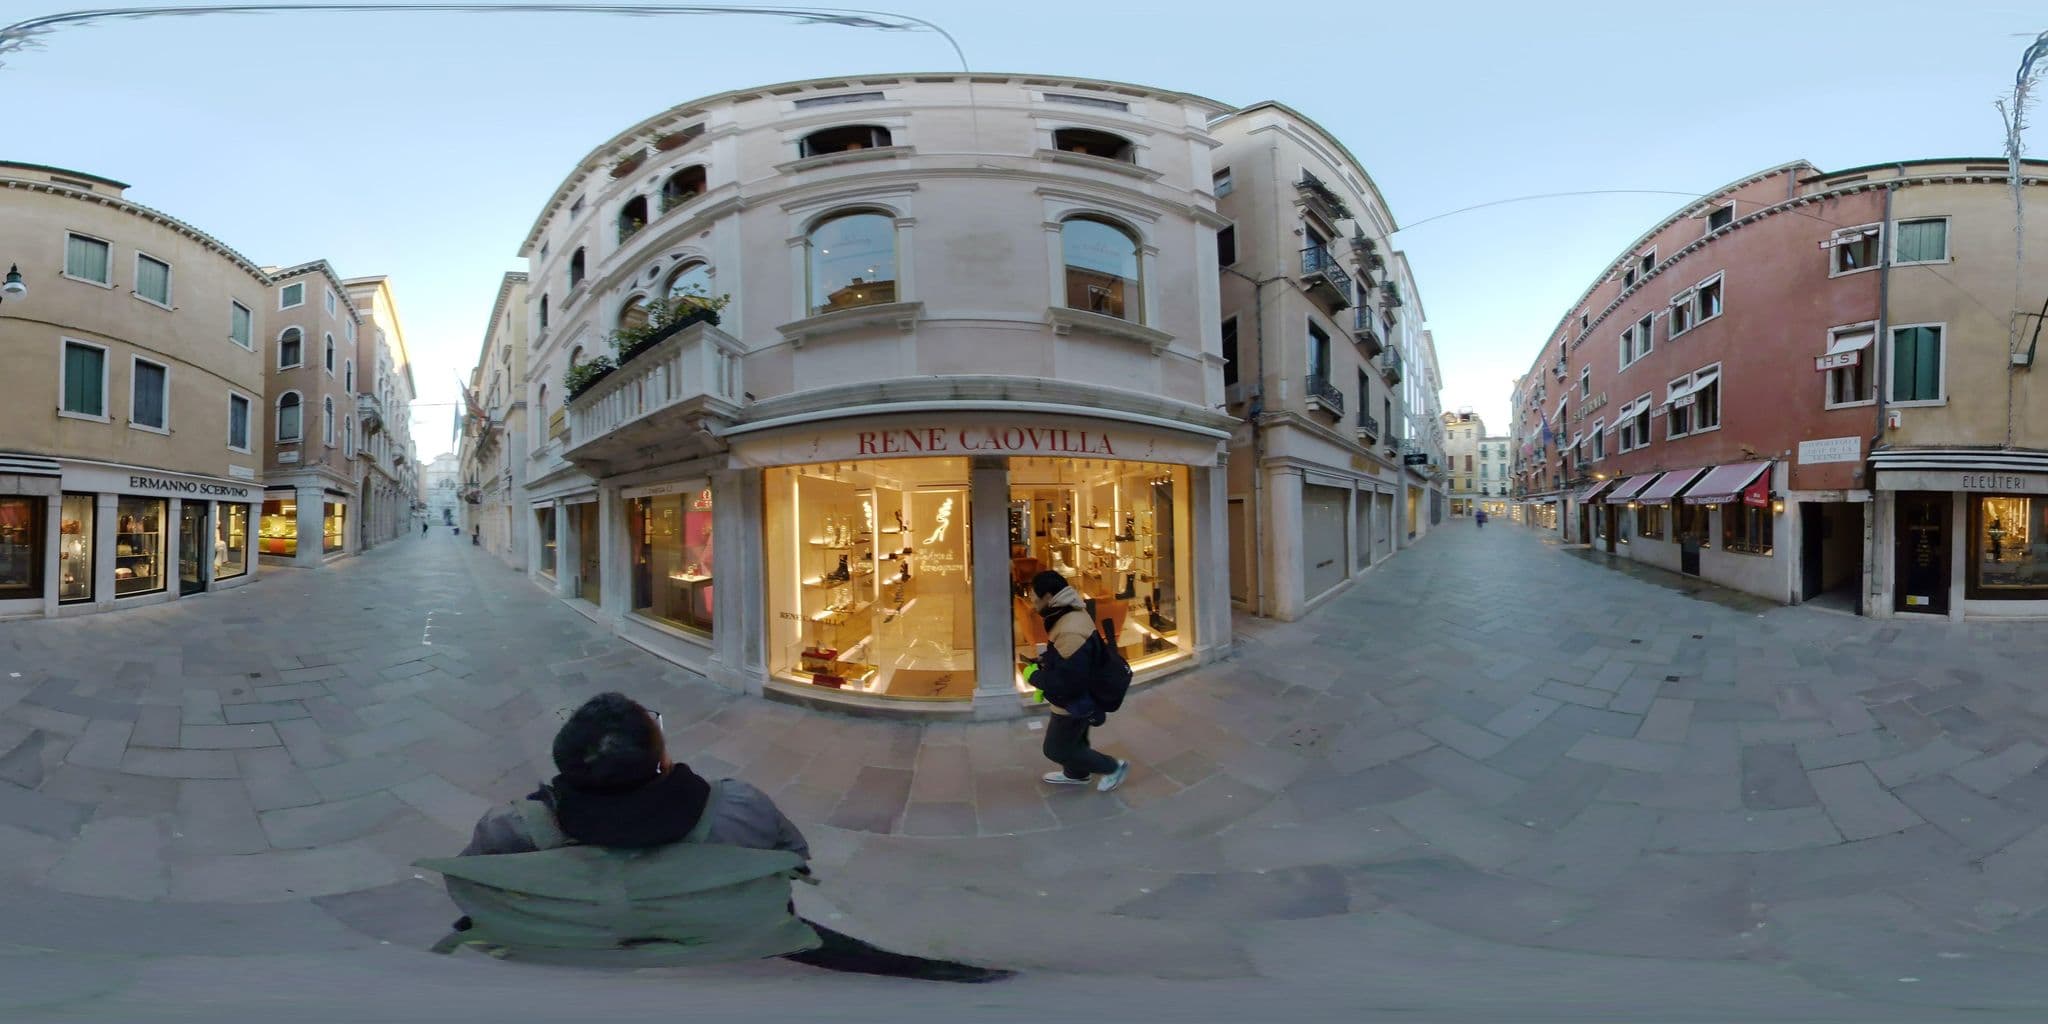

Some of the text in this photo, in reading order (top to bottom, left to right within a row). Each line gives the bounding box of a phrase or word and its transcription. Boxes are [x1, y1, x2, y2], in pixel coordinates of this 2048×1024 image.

[857, 426, 1115, 455] RENE CAOVILLA
[129, 476, 248, 498] ERMANNO SCERVINO
[1962, 475, 2026, 490] ELEUTERI
